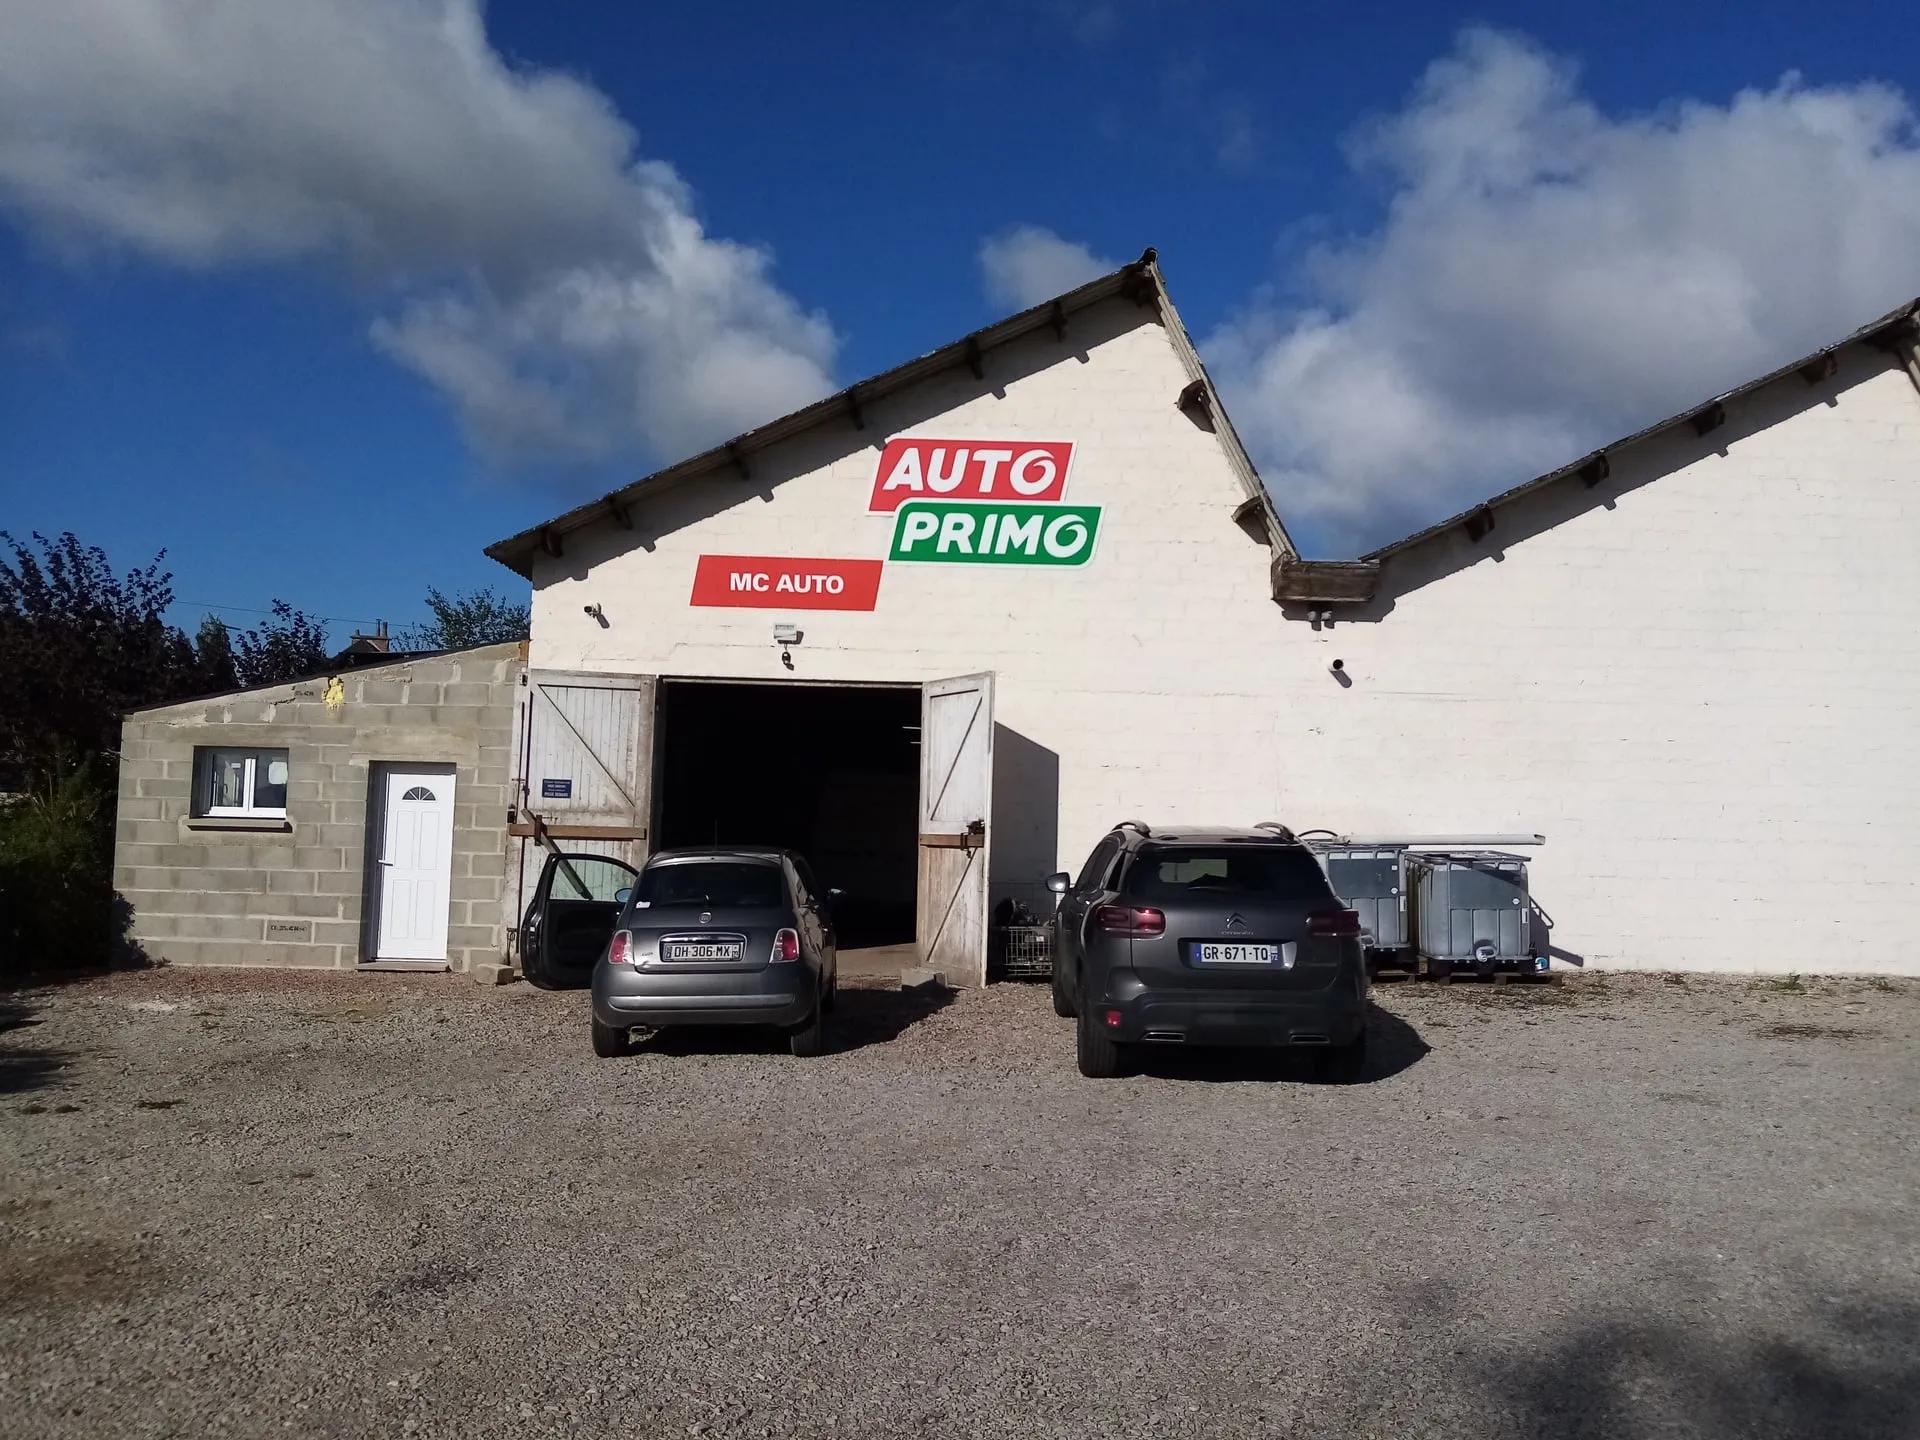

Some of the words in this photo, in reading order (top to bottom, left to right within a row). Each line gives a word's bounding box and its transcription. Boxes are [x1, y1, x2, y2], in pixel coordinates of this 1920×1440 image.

[882, 447, 1057, 496] AUTO
[900, 511, 1088, 559] PRIMO
[730, 572, 769, 592] MC
[776, 574, 844, 594] AUTO
